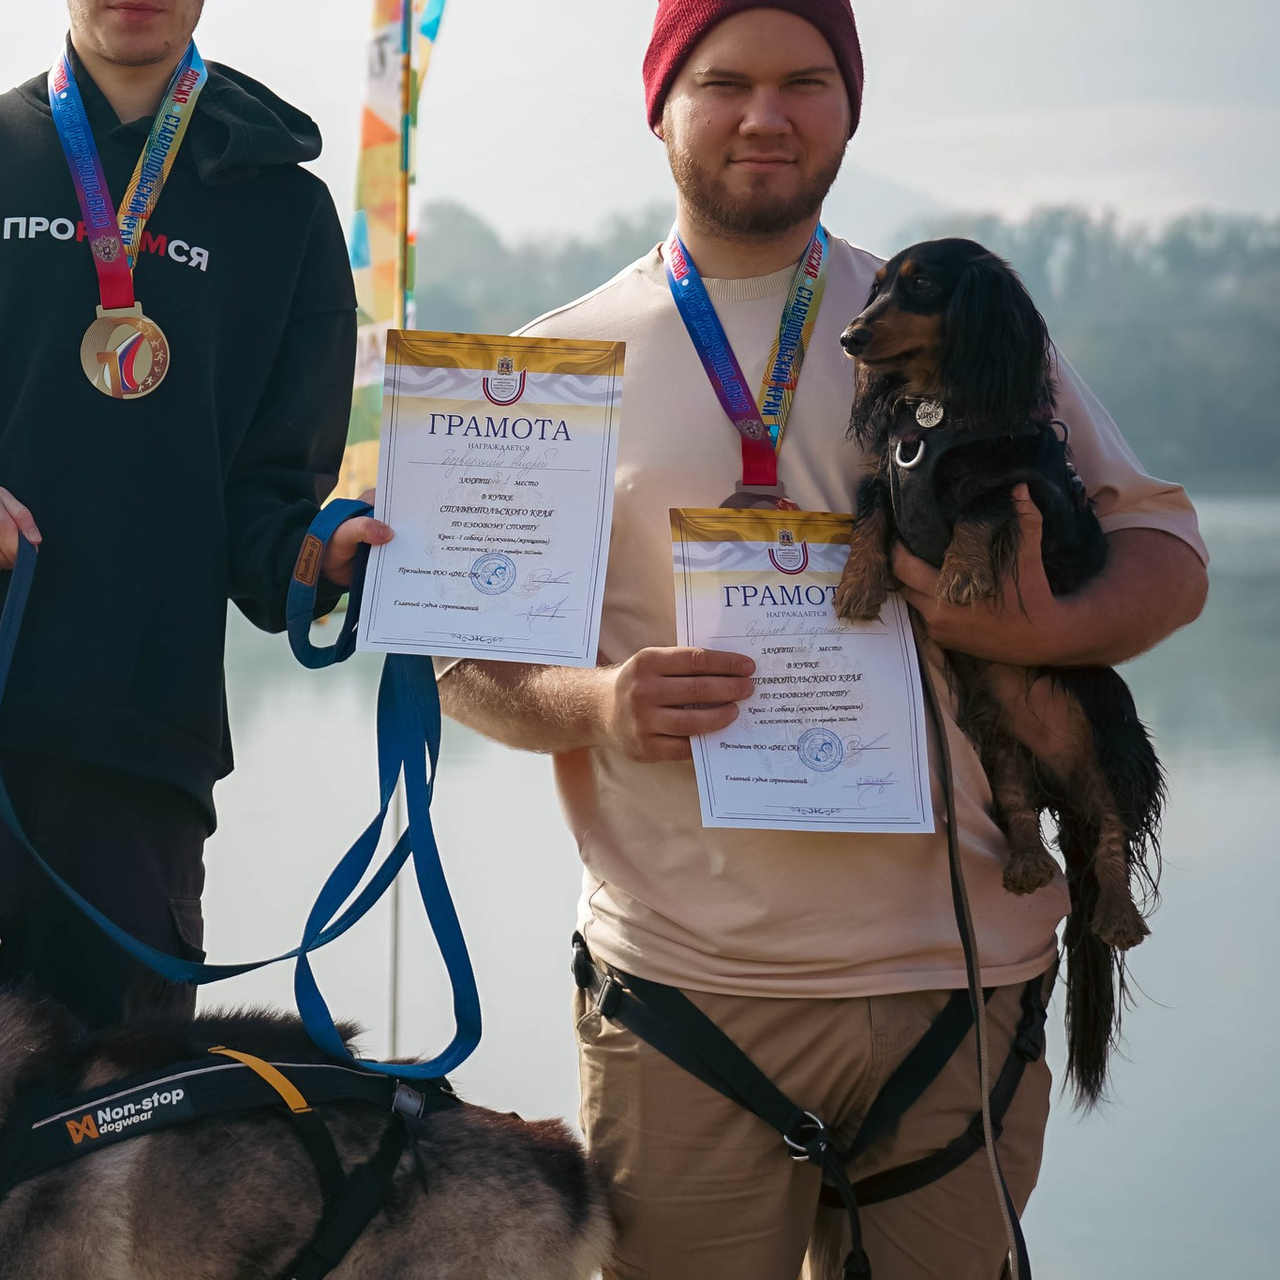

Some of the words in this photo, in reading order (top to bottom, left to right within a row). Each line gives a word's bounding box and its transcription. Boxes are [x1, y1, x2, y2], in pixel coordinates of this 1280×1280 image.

[172, 67, 201, 105] РОССИЯ
[128, 114, 181, 214] СТАВРОПОЛЬСКИЙ
[771, 286, 814, 383] СТАВРОПОЛЬСКИЙ
[428, 413, 572, 441] ГРАМОТА
[468, 442, 530, 452] НАГРАЖДАЕТСЯ
[440, 505, 528, 517] СТАВРОПОЛЬСКОГО
[529, 509, 555, 518] КРАЯ
[399, 567, 431, 576] Президент
[723, 585, 839, 607] ГРАМОТ
[750, 674, 837, 685] ТАВРОПОЛЬСКОГО
[838, 673, 863, 682] КРАЯ
[720, 742, 752, 750] Президент
[97, 1088, 184, 1124] Non-stop
[99, 1109, 153, 1132] dogwear
